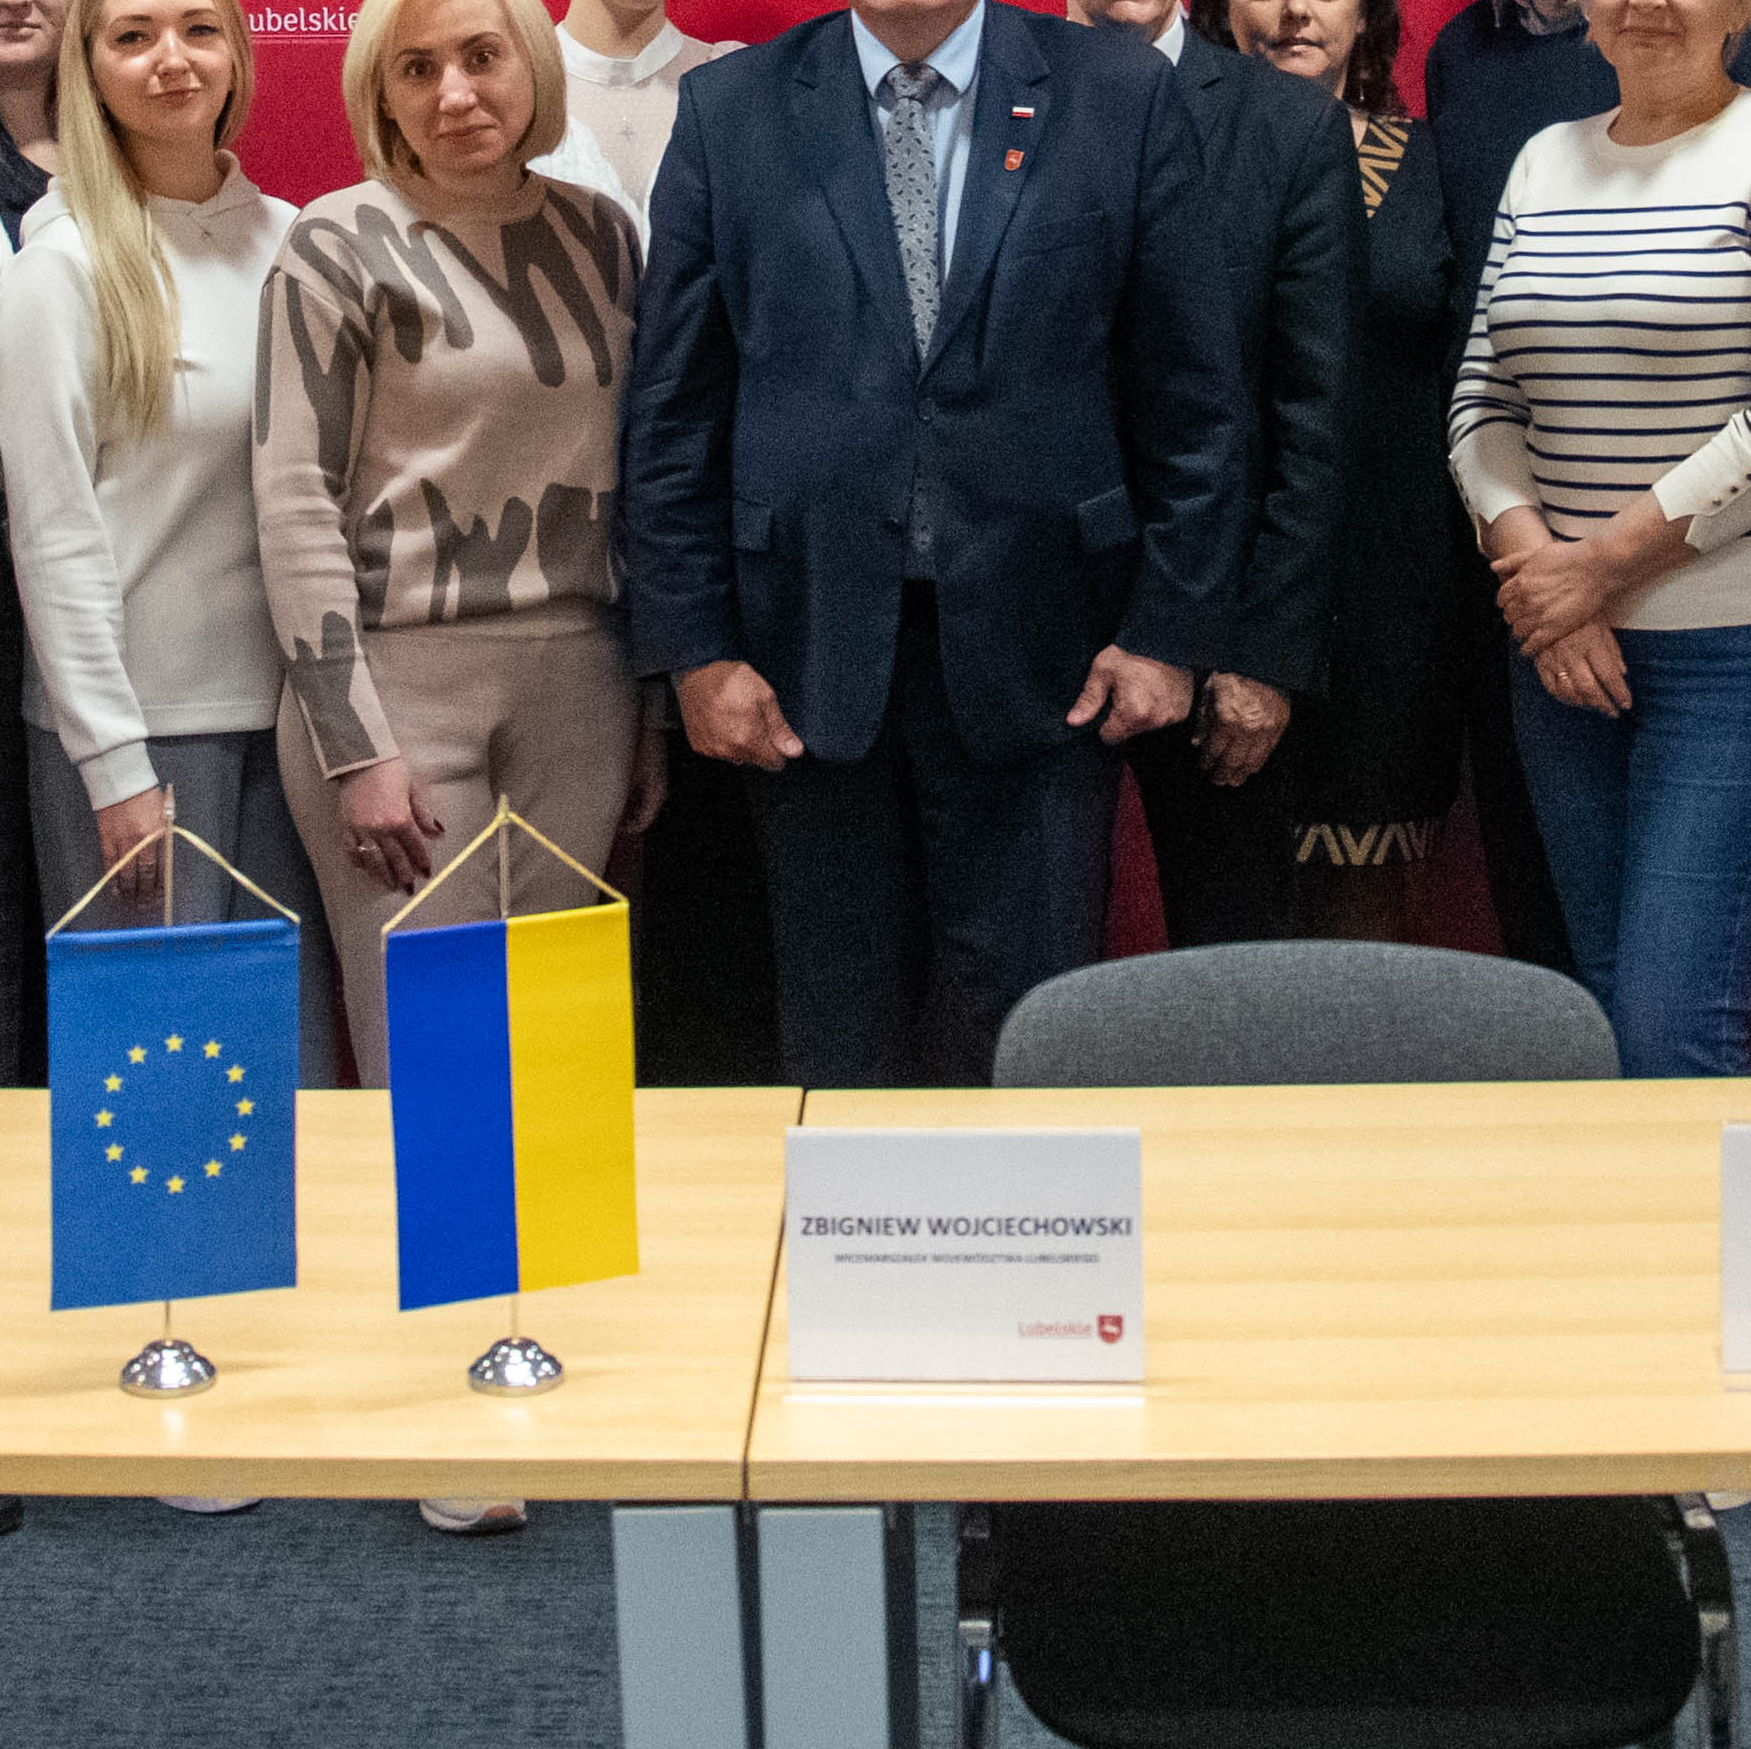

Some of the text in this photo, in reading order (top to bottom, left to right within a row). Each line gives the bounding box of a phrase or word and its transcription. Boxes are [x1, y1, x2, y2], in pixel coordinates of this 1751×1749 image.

[248, 6, 362, 33] ubelskie
[800, 1216, 1133, 1237] ZBIGNIEW WOJCIECHOWSKI
